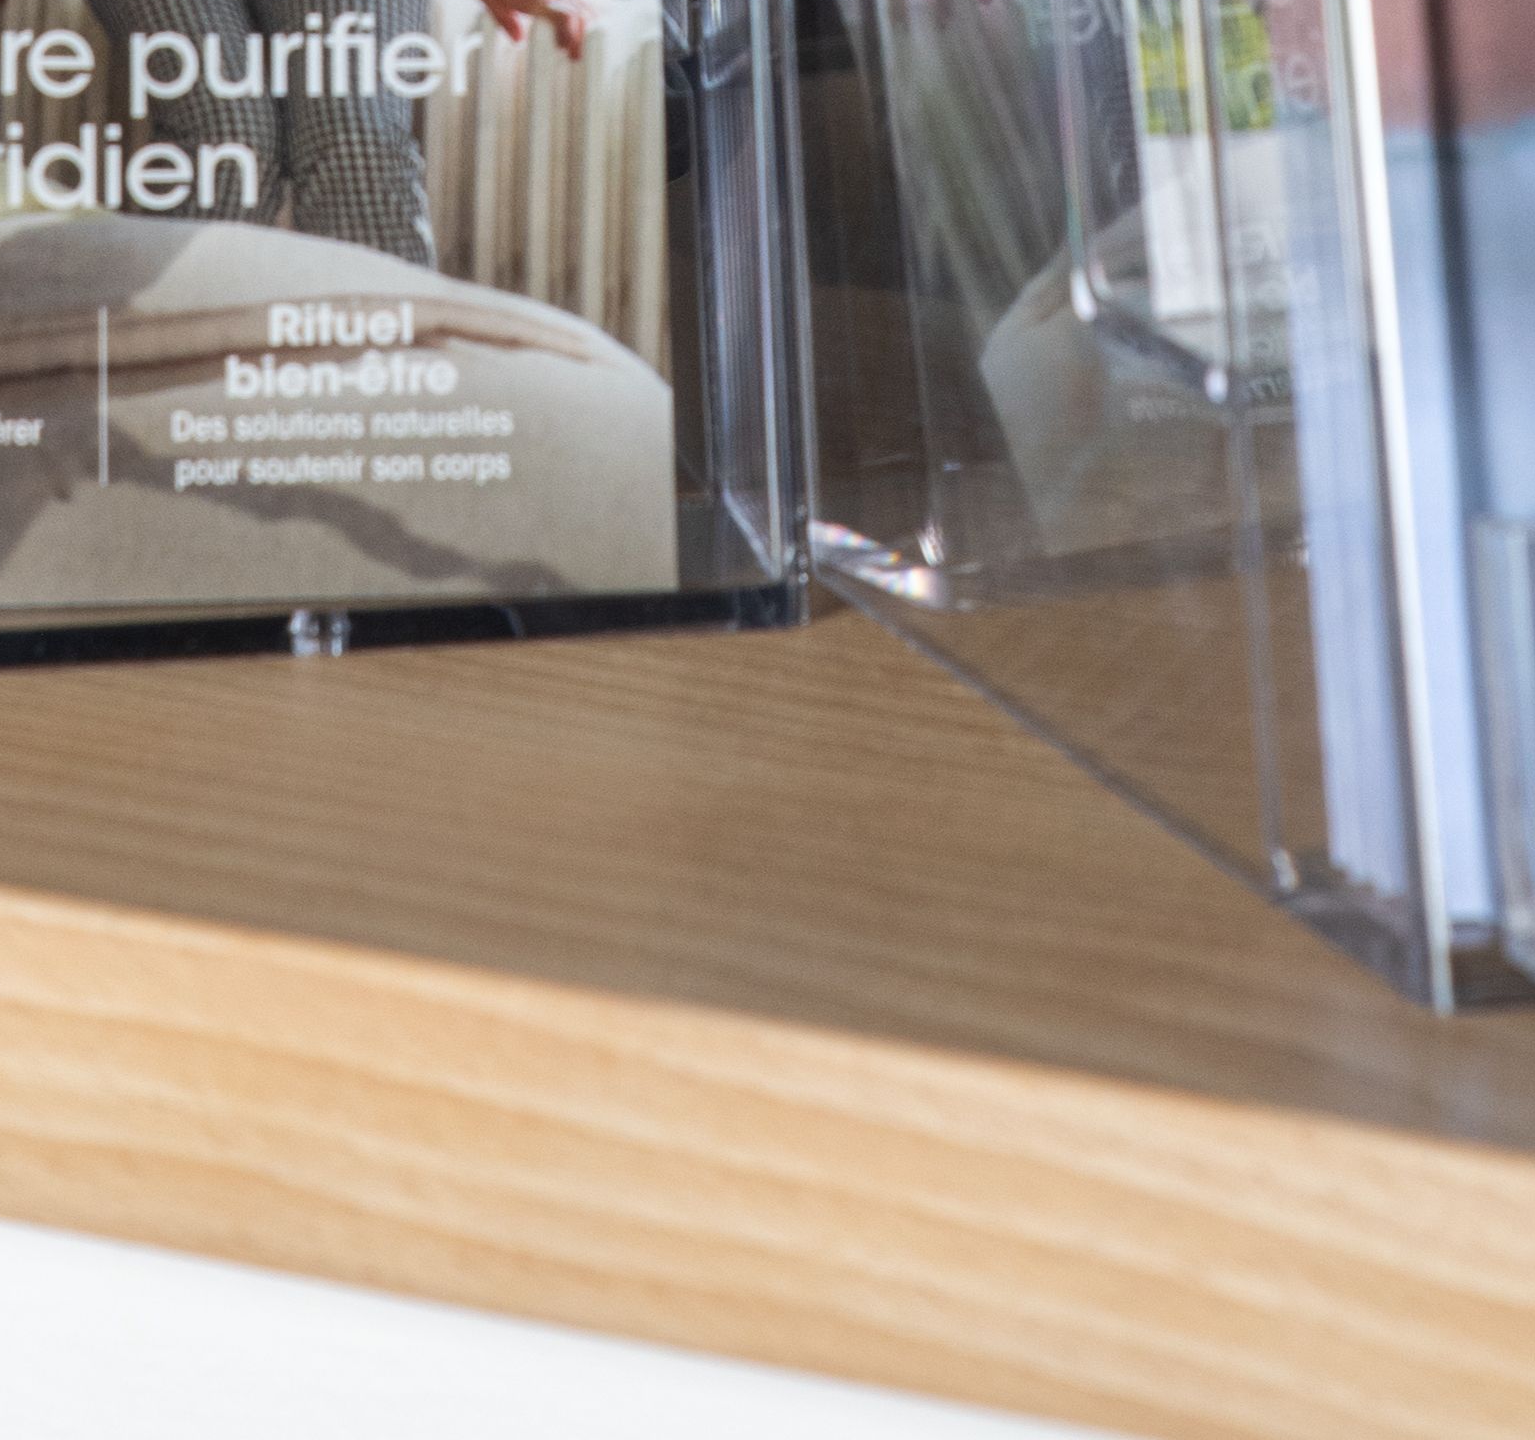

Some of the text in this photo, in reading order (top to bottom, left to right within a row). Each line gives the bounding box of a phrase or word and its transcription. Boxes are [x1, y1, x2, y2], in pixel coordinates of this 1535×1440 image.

[130, 11, 483, 118] purifier
[268, 301, 413, 347] Rituel
[225, 349, 459, 398] bien-être
[170, 404, 513, 442] Des solutions naturelles
[174, 457, 243, 492] pour
[371, 454, 425, 481] son
[431, 451, 510, 486] corps
